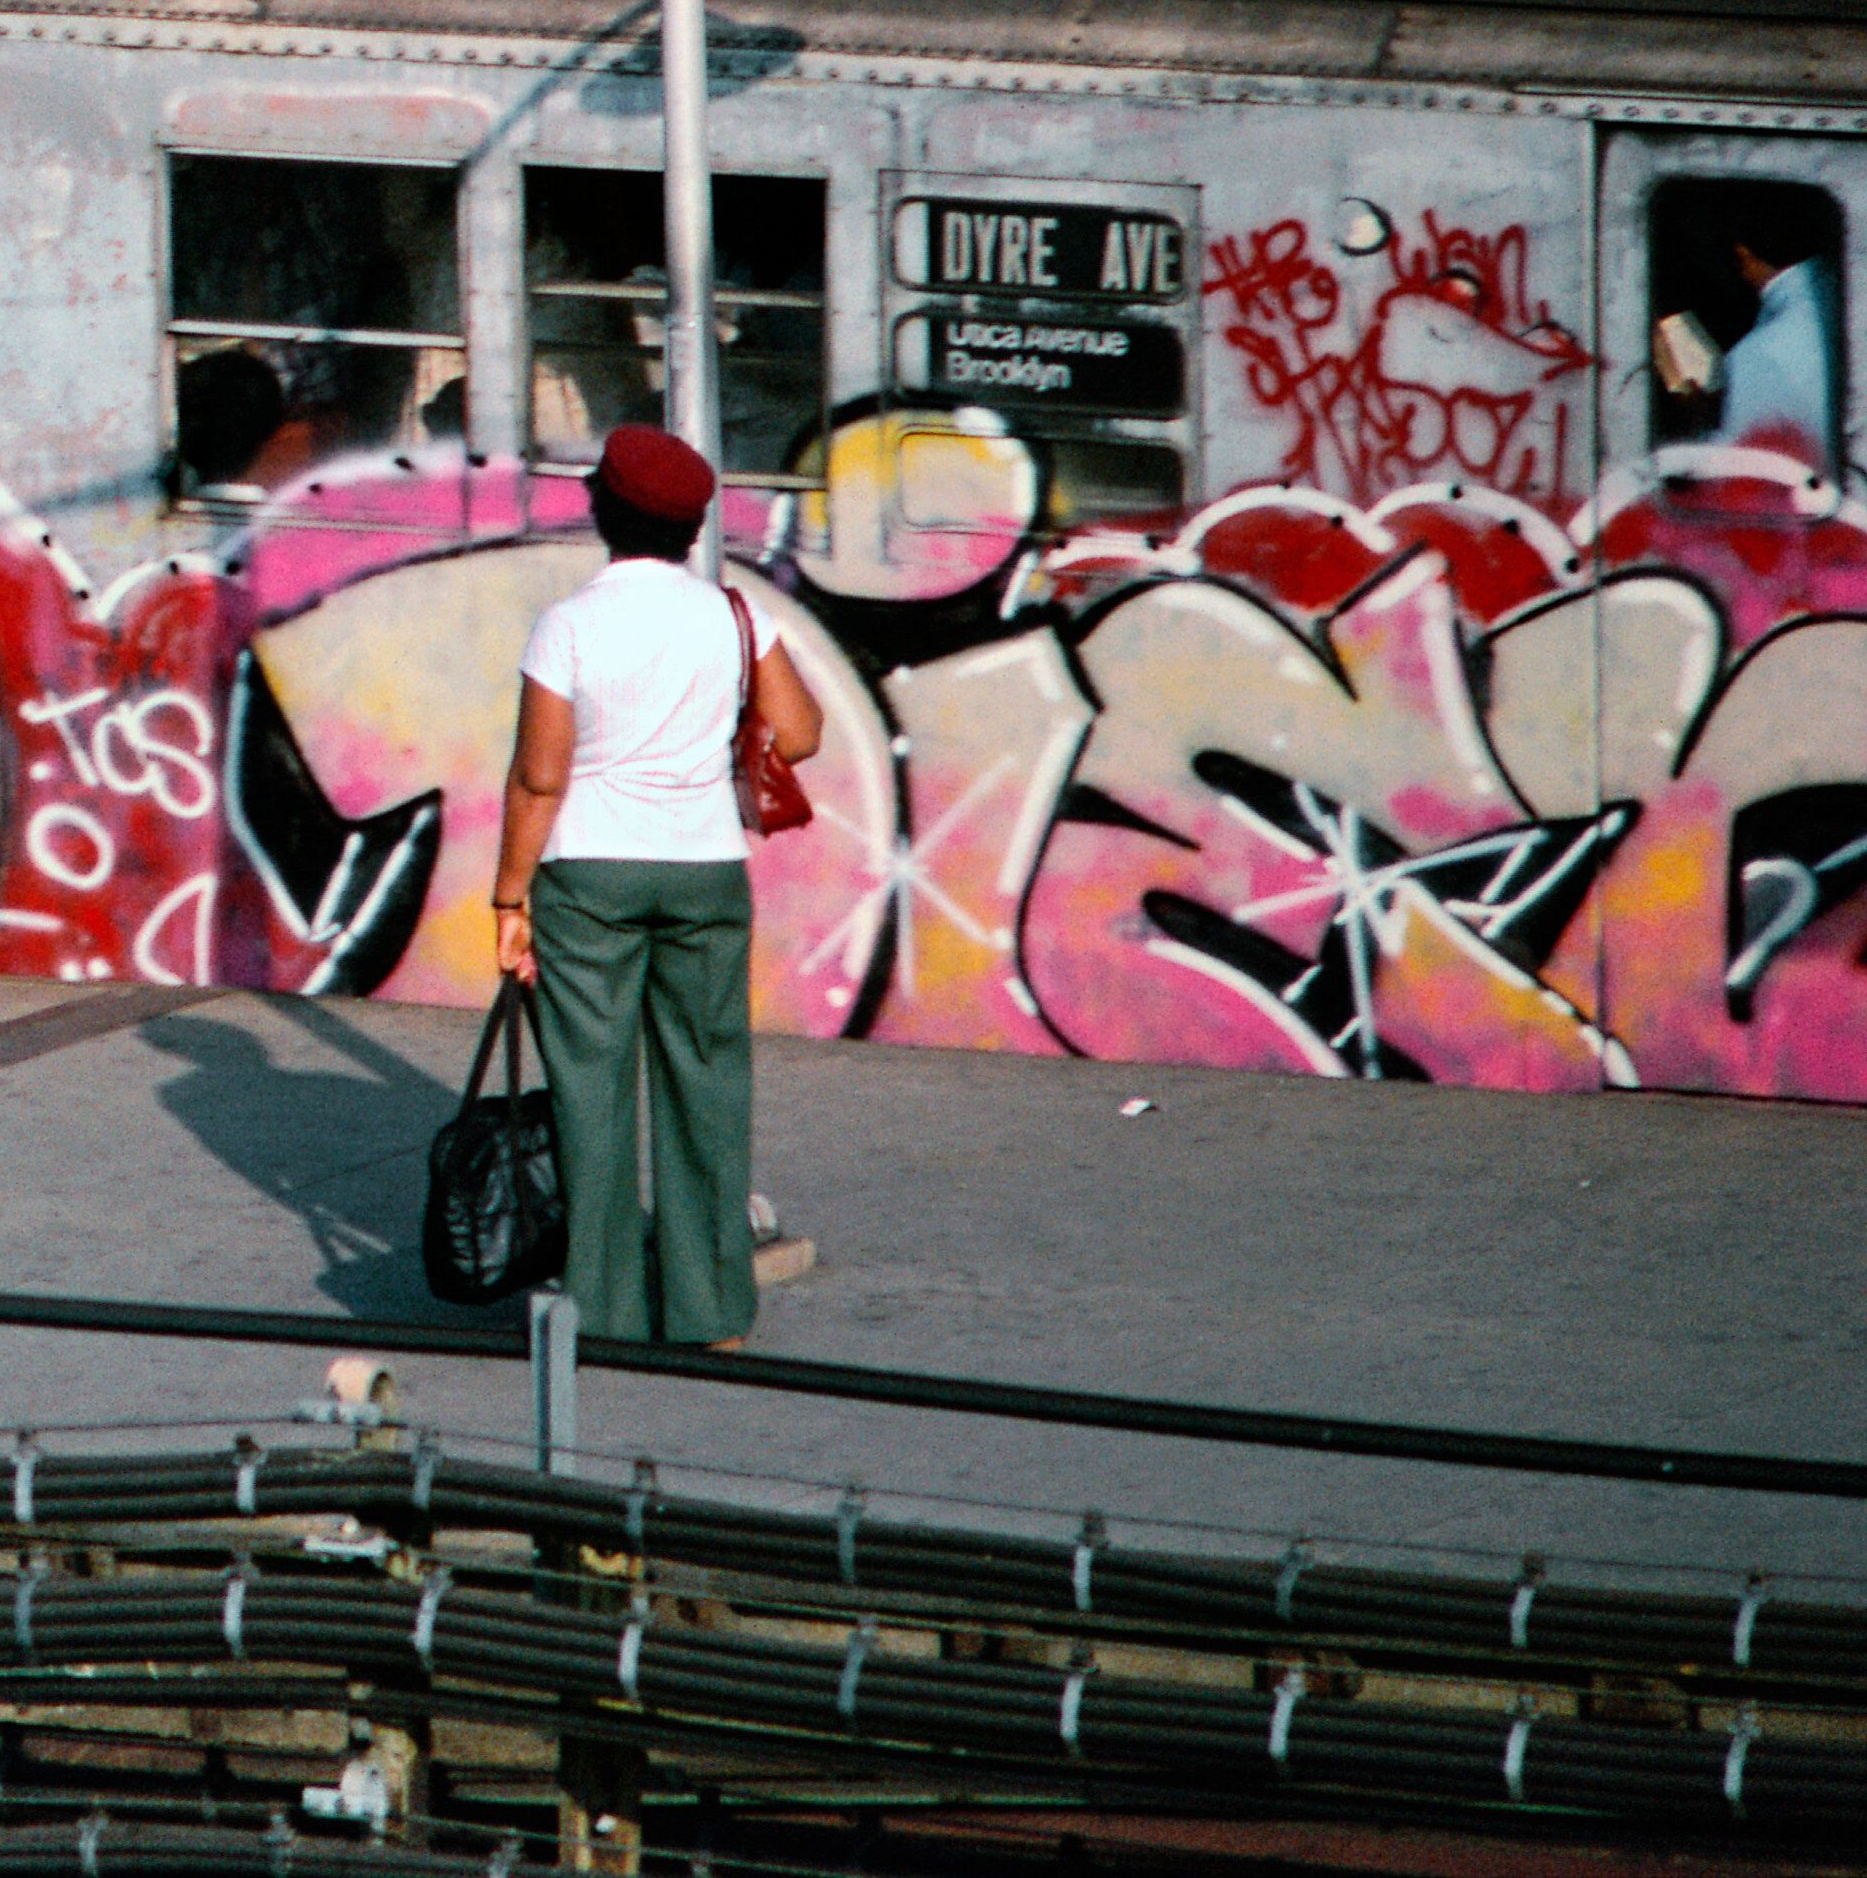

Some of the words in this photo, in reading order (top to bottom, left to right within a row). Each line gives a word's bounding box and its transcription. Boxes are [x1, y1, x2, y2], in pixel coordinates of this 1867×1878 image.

[942, 210, 1060, 287] DYRE
[1099, 220, 1181, 293] AVE
[945, 350, 1073, 393] Brooklyn
